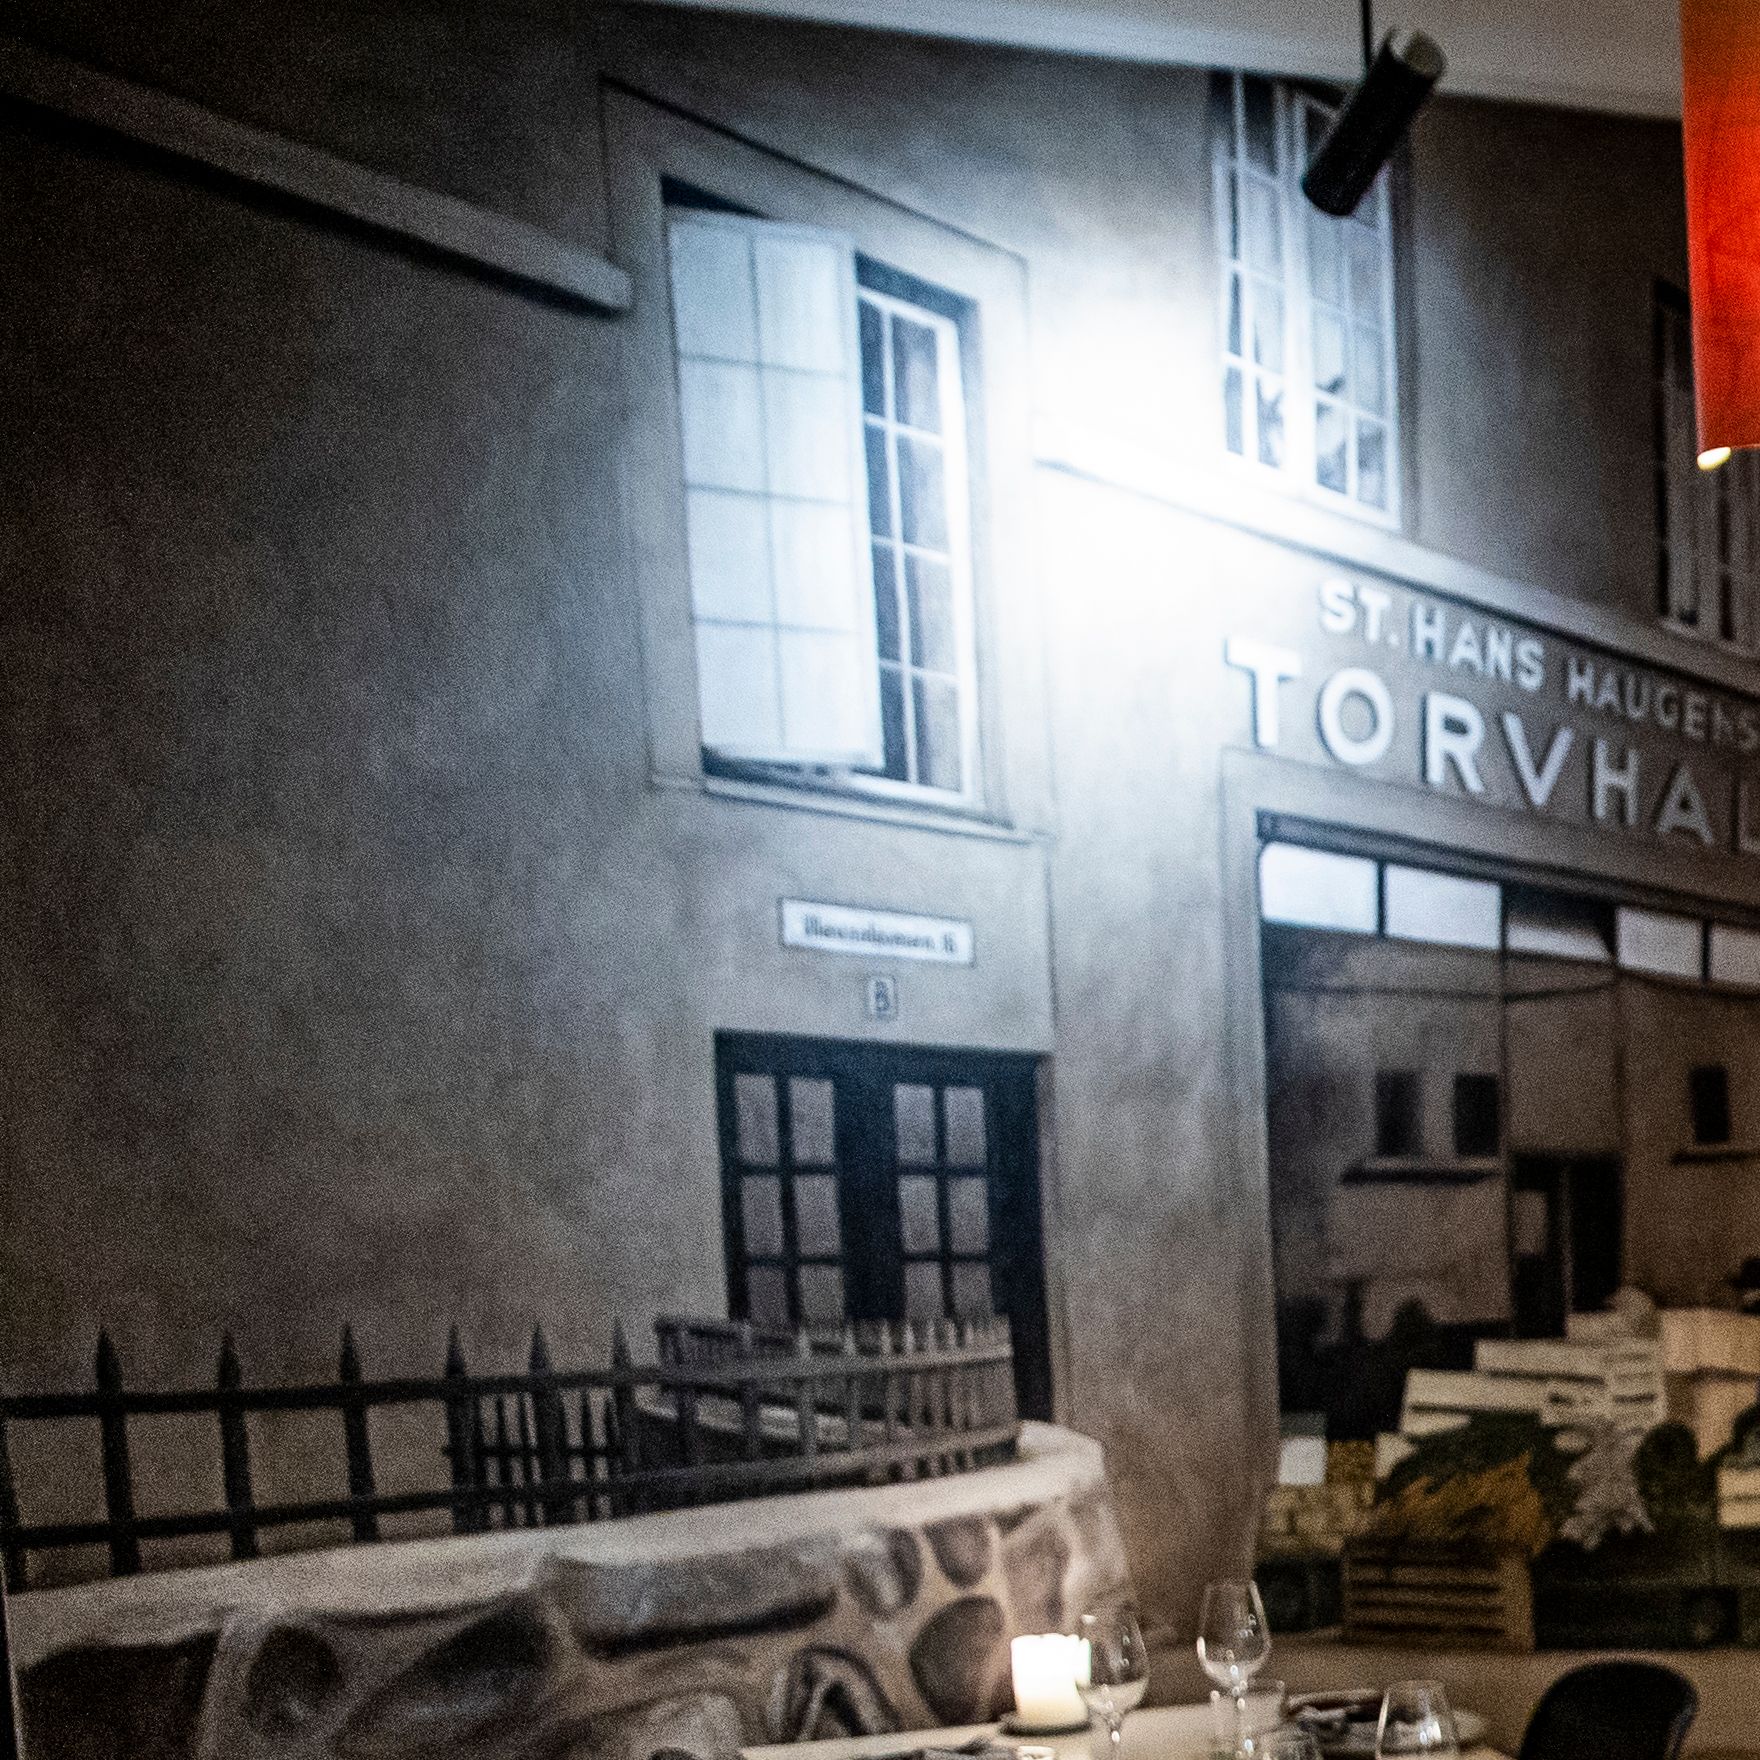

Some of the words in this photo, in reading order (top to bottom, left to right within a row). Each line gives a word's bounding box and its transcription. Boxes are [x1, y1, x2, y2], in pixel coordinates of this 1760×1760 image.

[1318, 579, 1400, 645] ST.
[1410, 603, 1547, 692] HANS
[1567, 657, 1760, 752] HAUGENS
